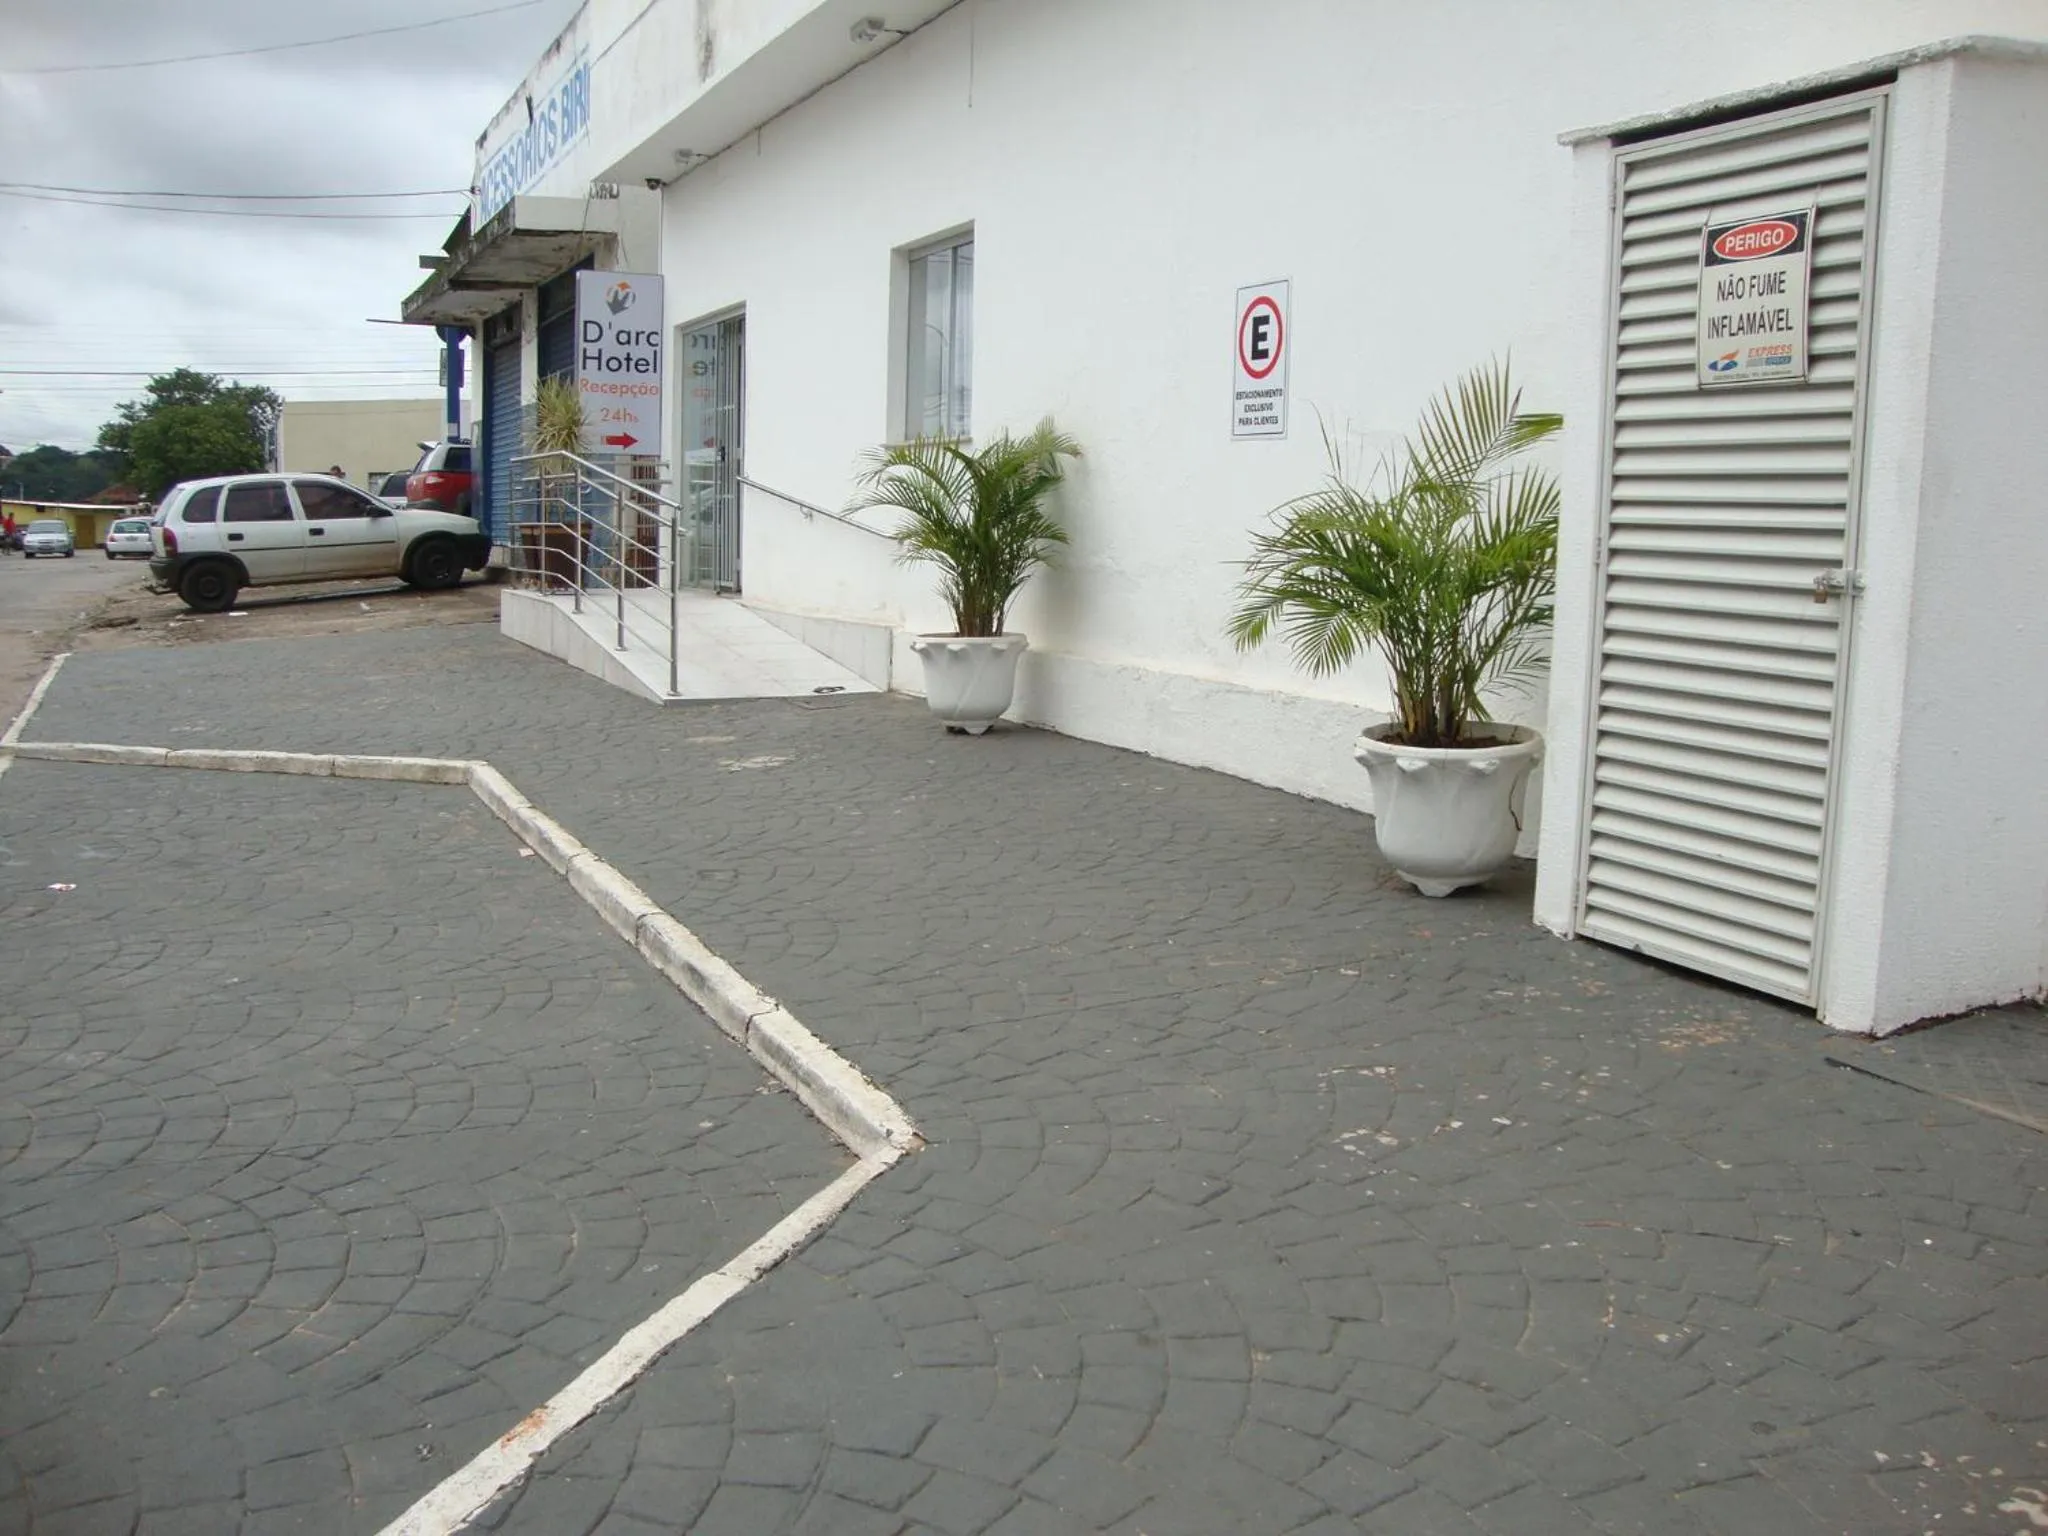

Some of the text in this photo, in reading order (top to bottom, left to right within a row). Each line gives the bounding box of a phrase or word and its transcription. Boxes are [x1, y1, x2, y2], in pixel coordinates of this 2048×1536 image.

[1724, 228, 1784, 254] PERIGO
[1717, 271, 1786, 302] NÃO FUME
[582, 320, 659, 347] D'arc
[1707, 305, 1794, 339] INFLAMÁVEL
[1251, 315, 1270, 361] E
[1748, 344, 1793, 357] EXPRESS
[582, 348, 658, 373] Hotel
[579, 378, 659, 398] Recepção
[1236, 388, 1282, 400] ESTACIONAMENTO
[1244, 402, 1273, 412] EXCLUSIVO
[1239, 416, 1278, 425] PARA CLIENTES
